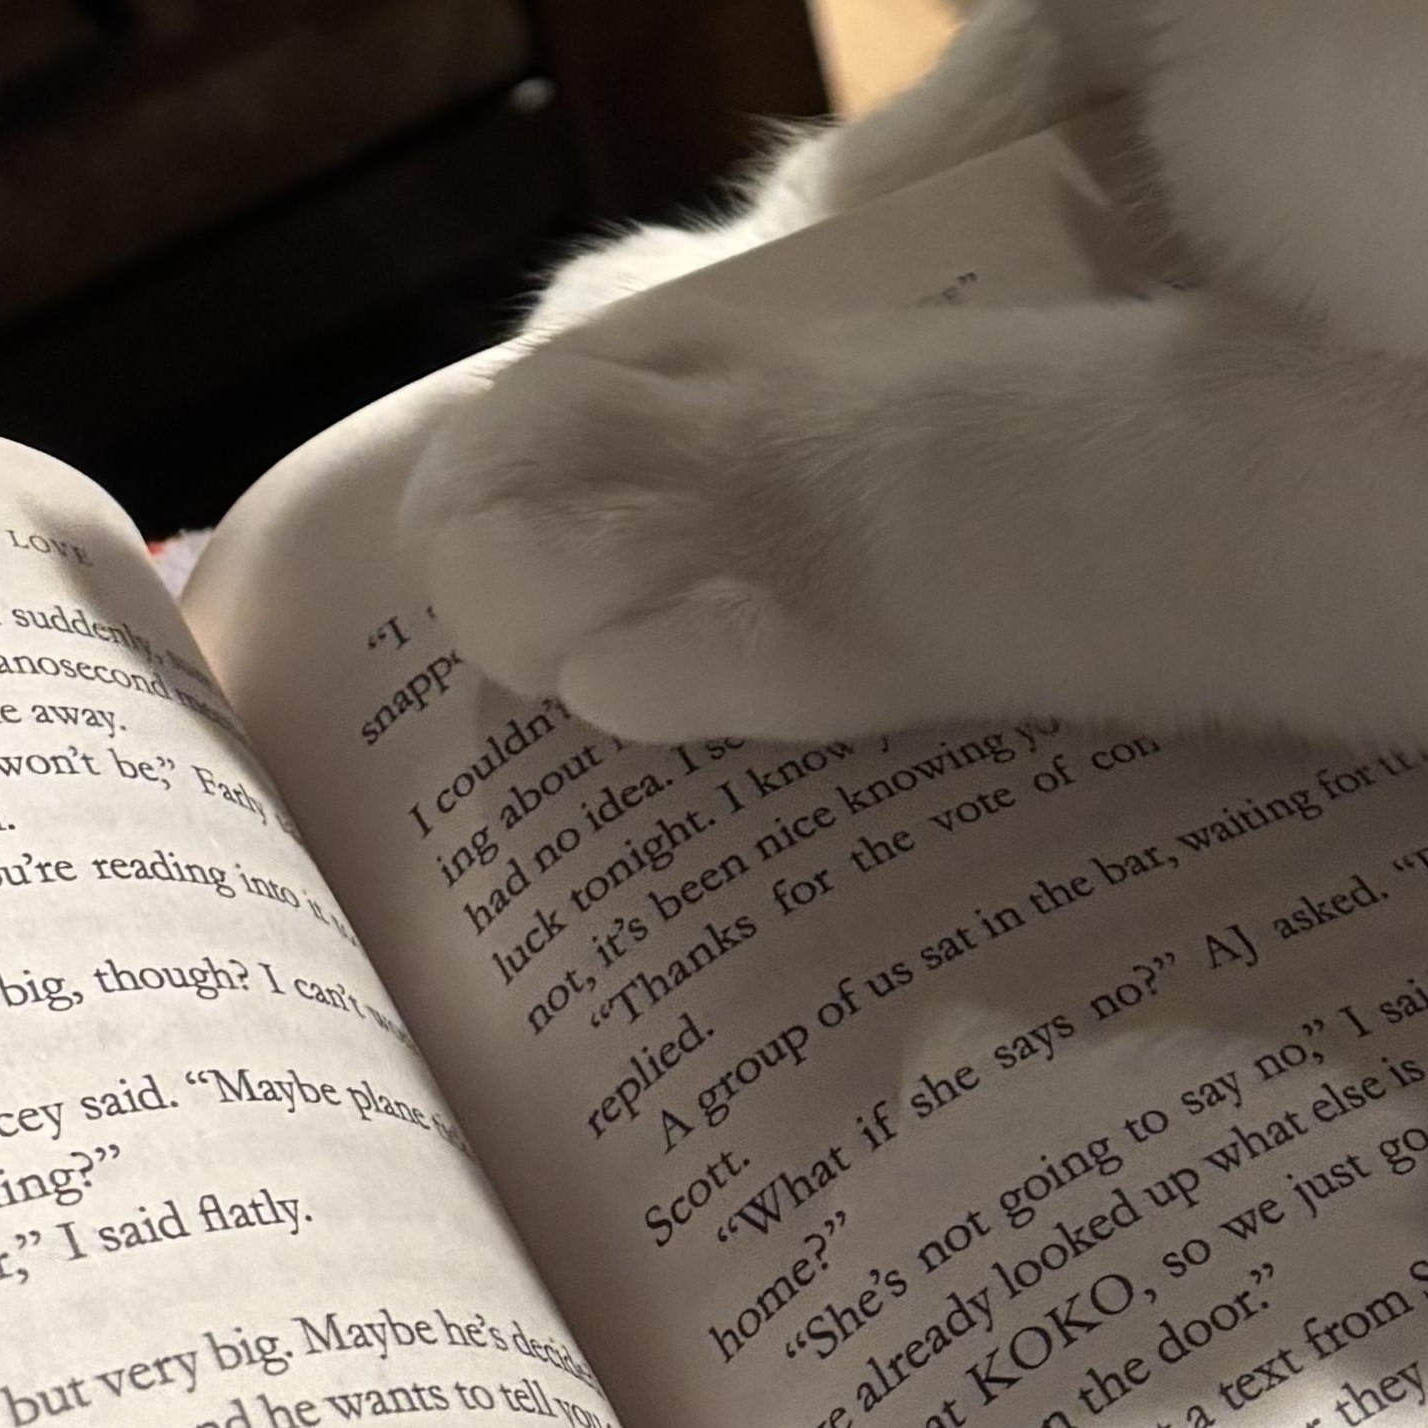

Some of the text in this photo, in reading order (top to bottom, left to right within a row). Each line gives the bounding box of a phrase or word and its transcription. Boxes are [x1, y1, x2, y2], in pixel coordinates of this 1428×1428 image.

[6, 529, 87, 565] LOVE
[30, 704, 127, 739] away.
[191, 765, 267, 826] Farly
[436, 744, 604, 889] ing about
[462, 773, 674, 937] had idea.
[90, 848, 238, 901] reading
[232, 862, 301, 911] into
[491, 810, 717, 987] luck tonight.
[527, 730, 1017, 1036] not, it’s been nice knowing
[590, 787, 1017, 1029] “Thanks for the vote
[92, 956, 250, 1001] though?
[292, 976, 369, 1021] can’t
[697, 764, 1378, 1128] group sat the bar, waiting for
[79, 1073, 179, 1121] said.
[184, 1067, 343, 1115] “Maybe
[346, 1080, 432, 1132] plane
[587, 1011, 715, 1141] replied.
[716, 873, 1390, 1243] “What she says asked.
[97, 1199, 192, 1253] said
[198, 1188, 313, 1236] flatly.
[644, 1151, 751, 1248] Scott.
[785, 1268, 908, 1360] “She’s
[916, 1210, 992, 1275] not
[999, 1136, 1125, 1230] going
[1180, 1070, 1243, 1116] say
[856, 1286, 994, 1414] already
[990, 1187, 1144, 1300] looked
[1200, 1110, 1310, 1174] what
[1311, 1076, 1387, 1124] else
[707, 1209, 847, 1365] home?”
[964, 1273, 1158, 1407] KOKO,
[1285, 1154, 1373, 1220] just
[1077, 1261, 1275, 1416] the door.”
[94, 1350, 198, 1398] very
[202, 1326, 294, 1377] big.
[291, 1307, 440, 1361] Maybe
[256, 1393, 322, 1428] he
[323, 1382, 450, 1420] wants
[499, 1377, 560, 1419] tell
[1217, 1348, 1305, 1411] text
[1302, 1290, 1415, 1361] from
[1334, 1360, 1426, 1428] they
